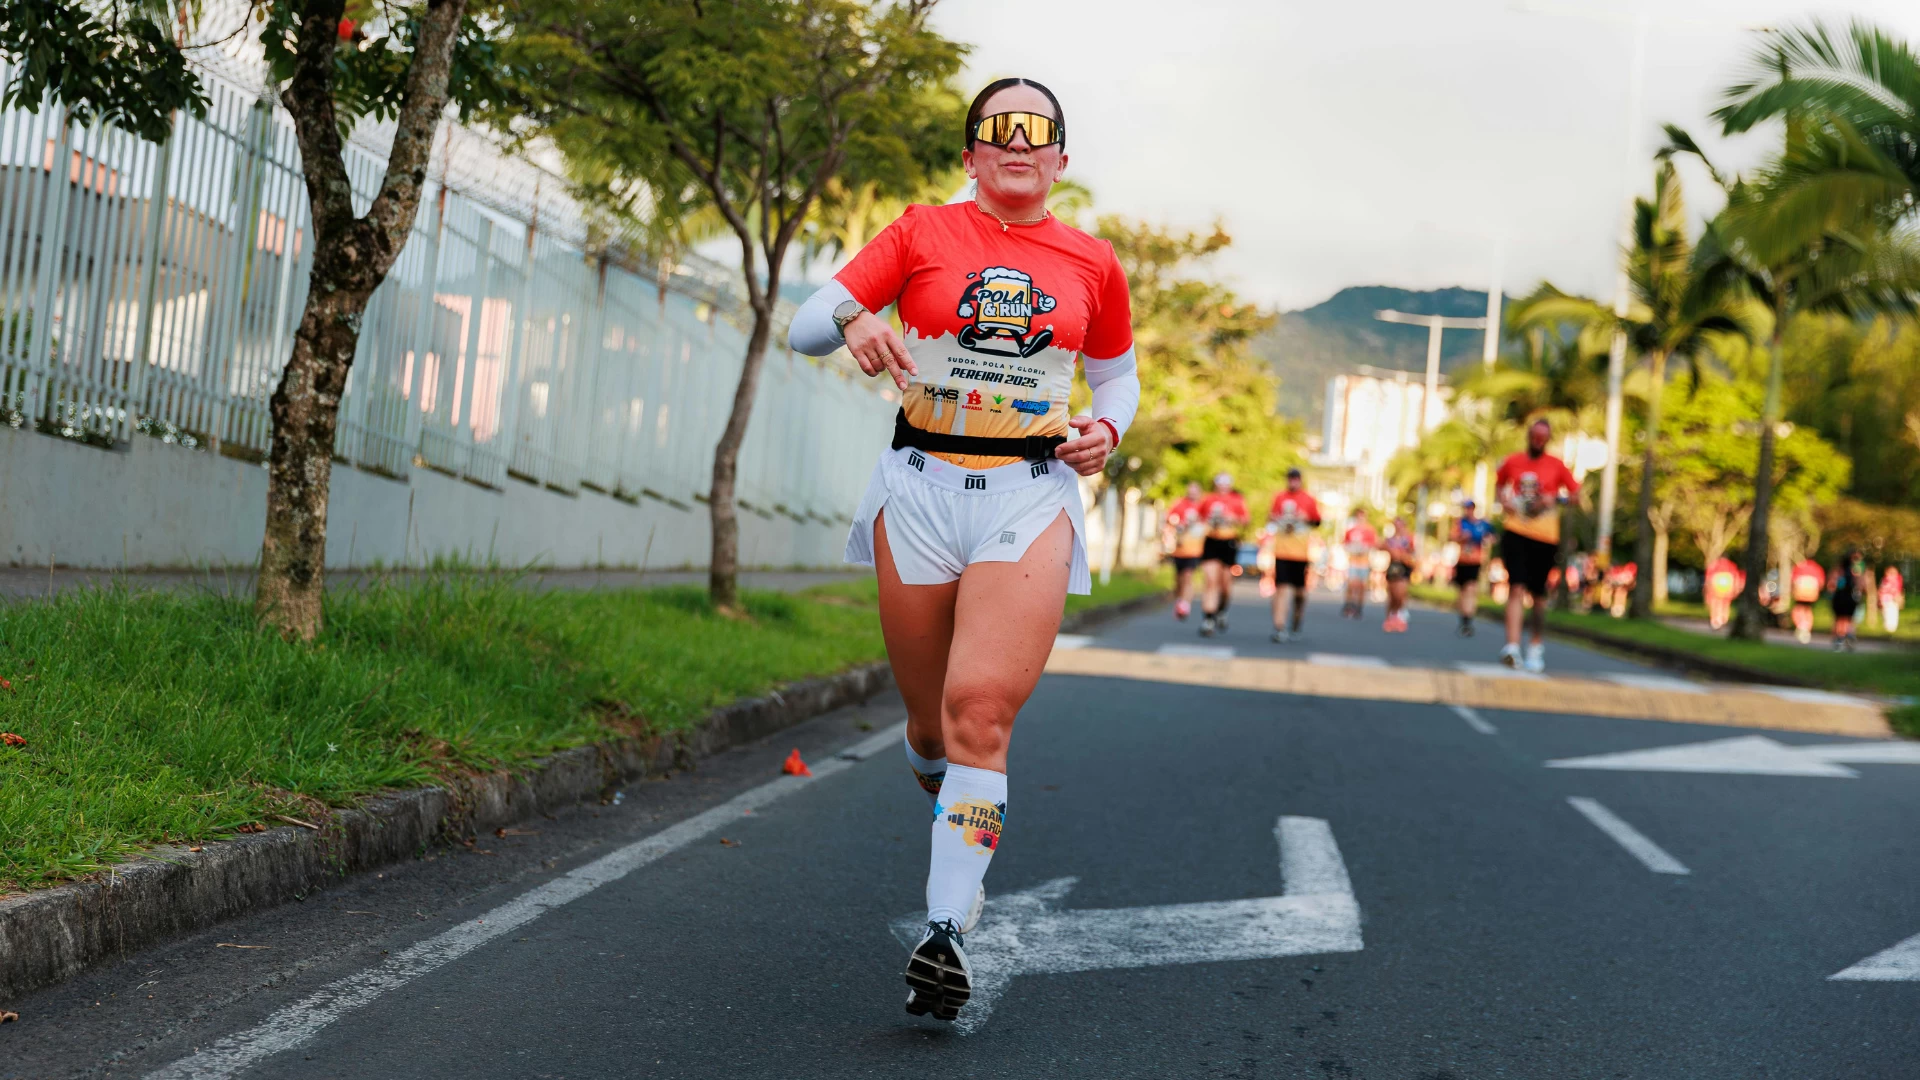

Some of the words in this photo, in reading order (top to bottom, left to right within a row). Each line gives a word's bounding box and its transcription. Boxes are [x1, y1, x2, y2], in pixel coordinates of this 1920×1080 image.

[977, 288, 1025, 304] POLA
[984, 302, 997, 317] &
[999, 303, 1032, 317] RUN
[947, 356, 979, 366] SUDOR,
[983, 361, 1005, 369] POLA
[1017, 366, 1046, 376] GLORIA
[950, 367, 1004, 384] PEREIRA
[1003, 374, 1039, 388] 2025
[969, 816, 1000, 835] HARD
